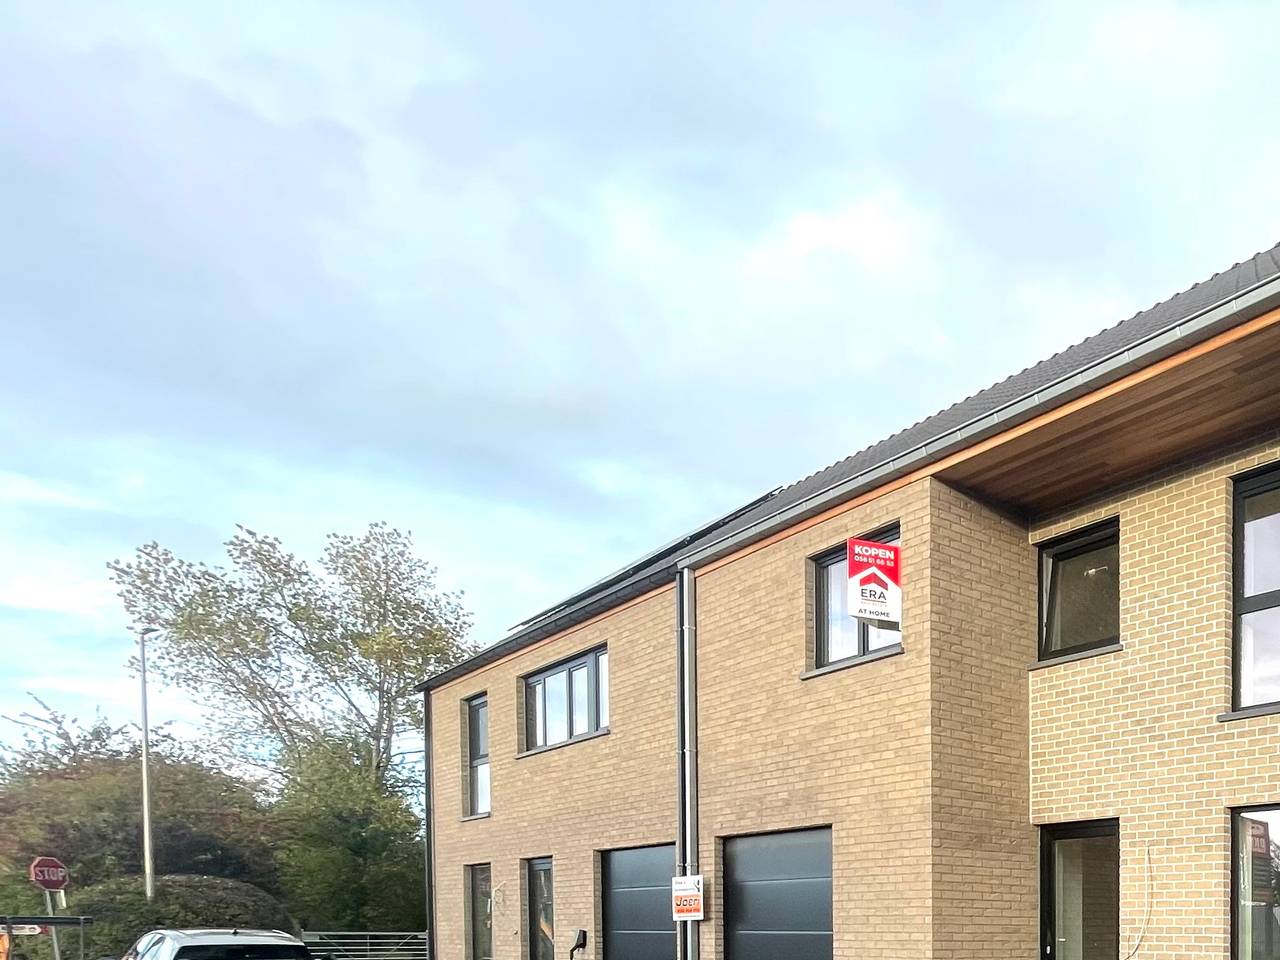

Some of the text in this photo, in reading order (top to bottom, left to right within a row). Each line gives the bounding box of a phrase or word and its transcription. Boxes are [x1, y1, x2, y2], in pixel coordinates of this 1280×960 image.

[854, 545, 894, 560] KOPEN
[860, 588, 887, 601] ERA
[869, 610, 890, 618] HOME
[35, 867, 66, 880] STOP
